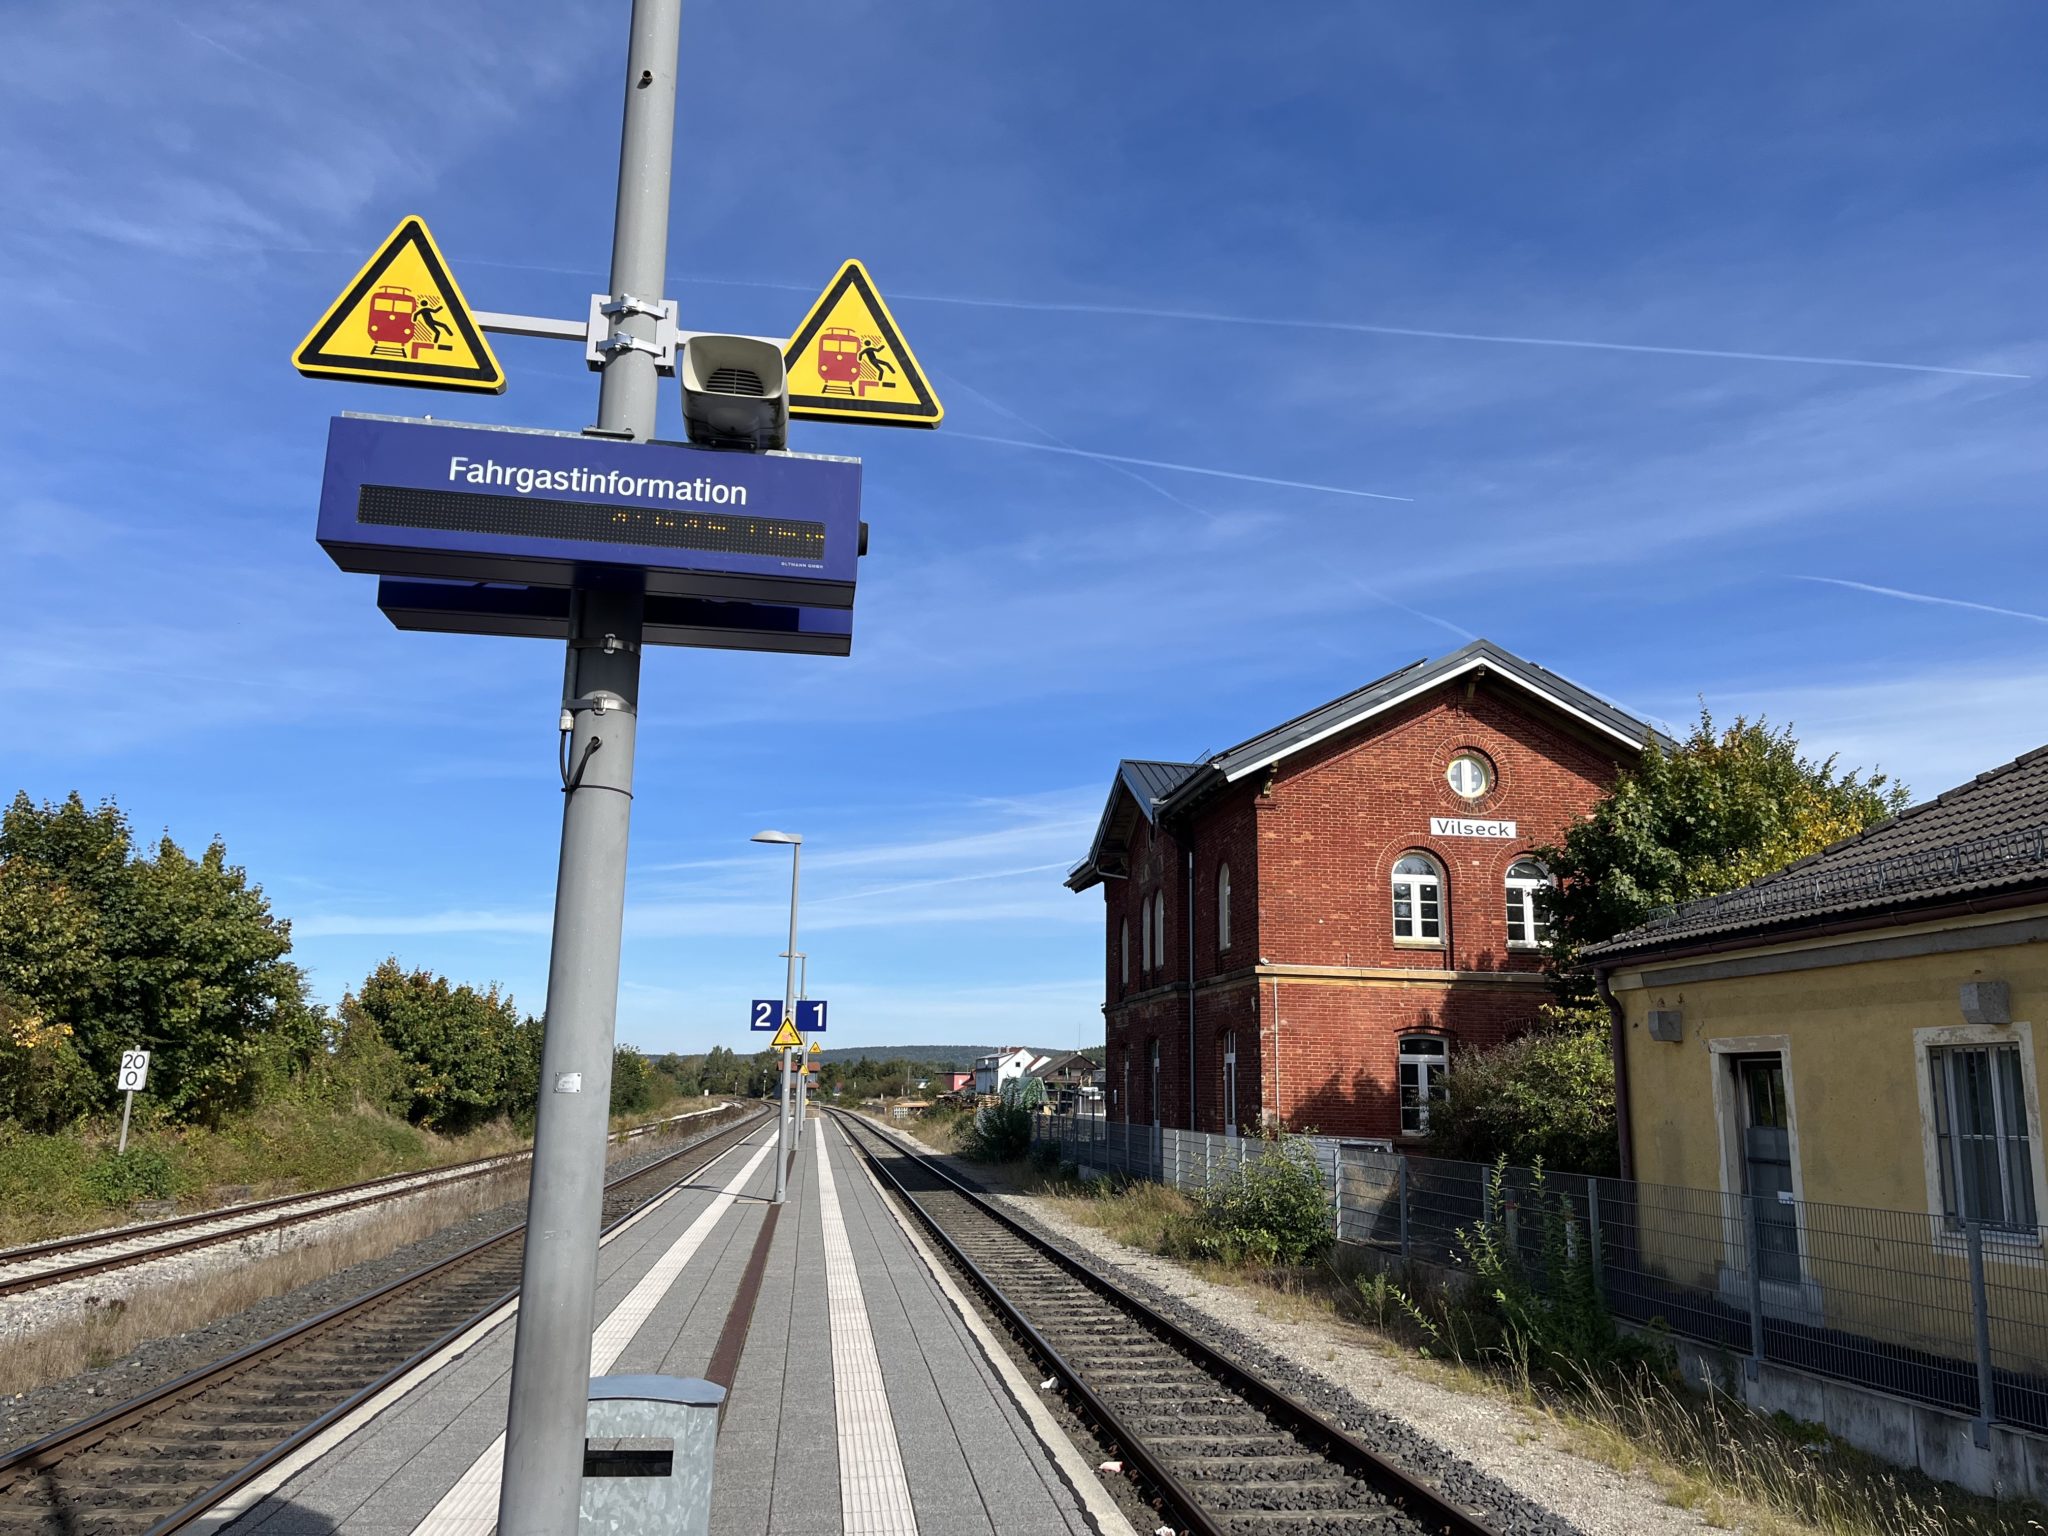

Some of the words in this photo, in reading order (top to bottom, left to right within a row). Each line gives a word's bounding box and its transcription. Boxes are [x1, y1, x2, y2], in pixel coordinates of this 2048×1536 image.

[449, 456, 747, 505] Fahrgastinformation
[1437, 820, 1510, 837] Vilseck
[754, 1002, 772, 1027] 2
[813, 1003, 824, 1027] 1
[122, 1053, 146, 1070] 20
[125, 1071, 138, 1086] 0
